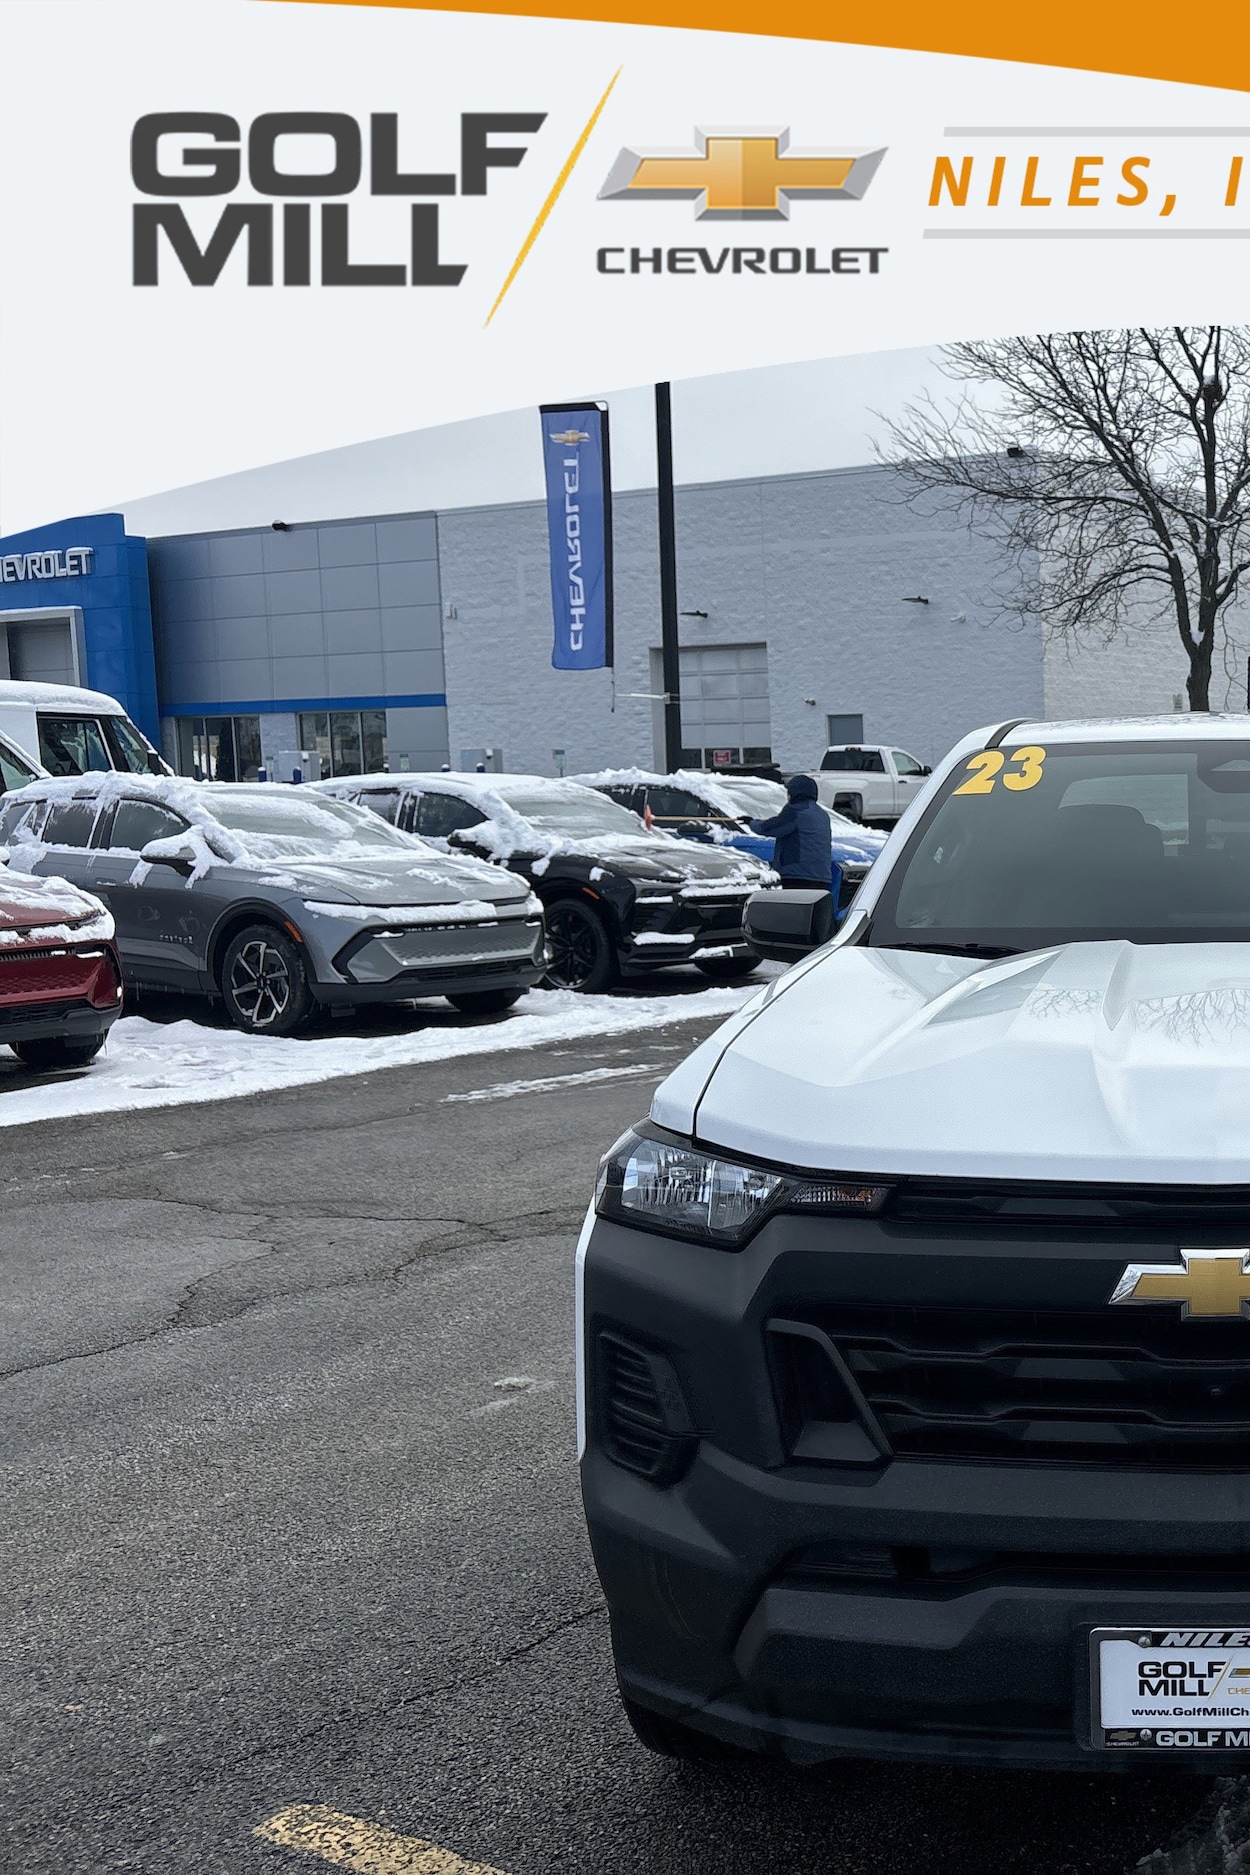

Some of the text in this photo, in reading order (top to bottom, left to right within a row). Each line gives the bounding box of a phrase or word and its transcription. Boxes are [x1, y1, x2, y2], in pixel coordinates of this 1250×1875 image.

[0, 548, 92, 583] EVROLET
[954, 746, 1046, 795] 23
[1138, 1661, 1226, 1679] GOLF
[1138, 1679, 1210, 1697] MILL
[1155, 1730, 1222, 1747] GOLF
